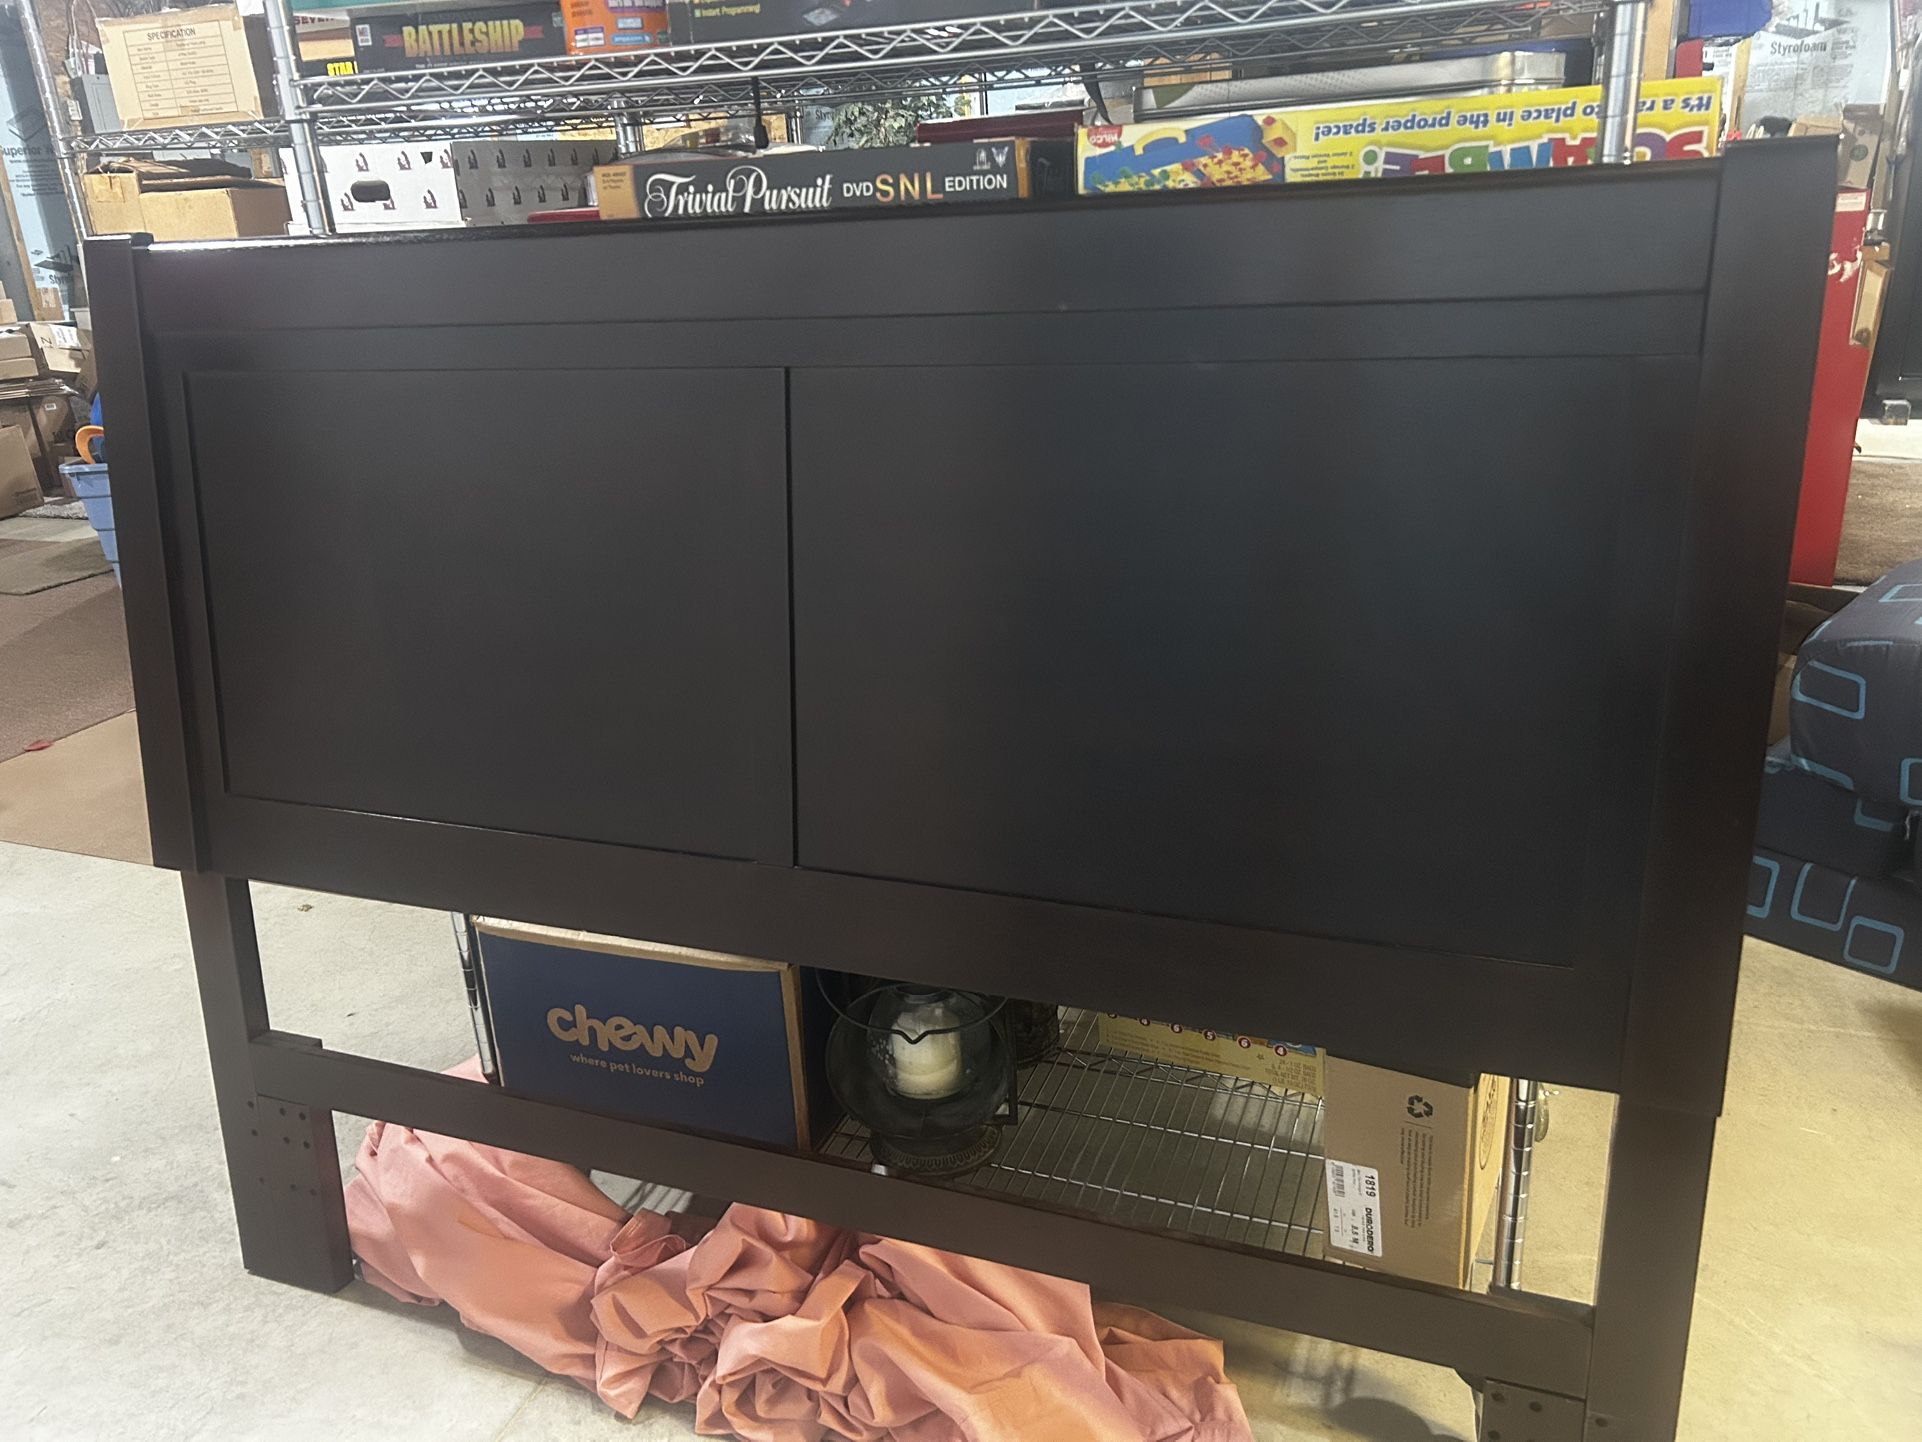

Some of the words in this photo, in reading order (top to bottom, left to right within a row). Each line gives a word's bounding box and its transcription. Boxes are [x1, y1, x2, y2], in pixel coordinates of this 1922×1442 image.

[147, 28, 197, 41] SPECIFICATION
[402, 19, 525, 57] BATTLESHIP
[1770, 40, 1827, 56] Styrofoam
[1521, 101, 1577, 123] place
[1662, 98, 1674, 110] a
[1681, 95, 1712, 112] It's
[1314, 118, 1377, 141] space!
[1381, 111, 1452, 133] proper
[1456, 112, 1489, 129] the
[1496, 110, 1514, 127] in
[645, 173, 737, 217] Trivial
[727, 165, 834, 213] Pursuit
[843, 182, 874, 197] DVD
[875, 172, 944, 203] SNL
[945, 174, 1008, 192] EDITION
[547, 1004, 718, 1072] chewy
[570, 1053, 607, 1068] where
[609, 1062, 630, 1073] pet
[632, 1063, 671, 1080] lovers
[673, 1072, 705, 1088] shop
[1365, 1174, 1376, 1198] 1819
